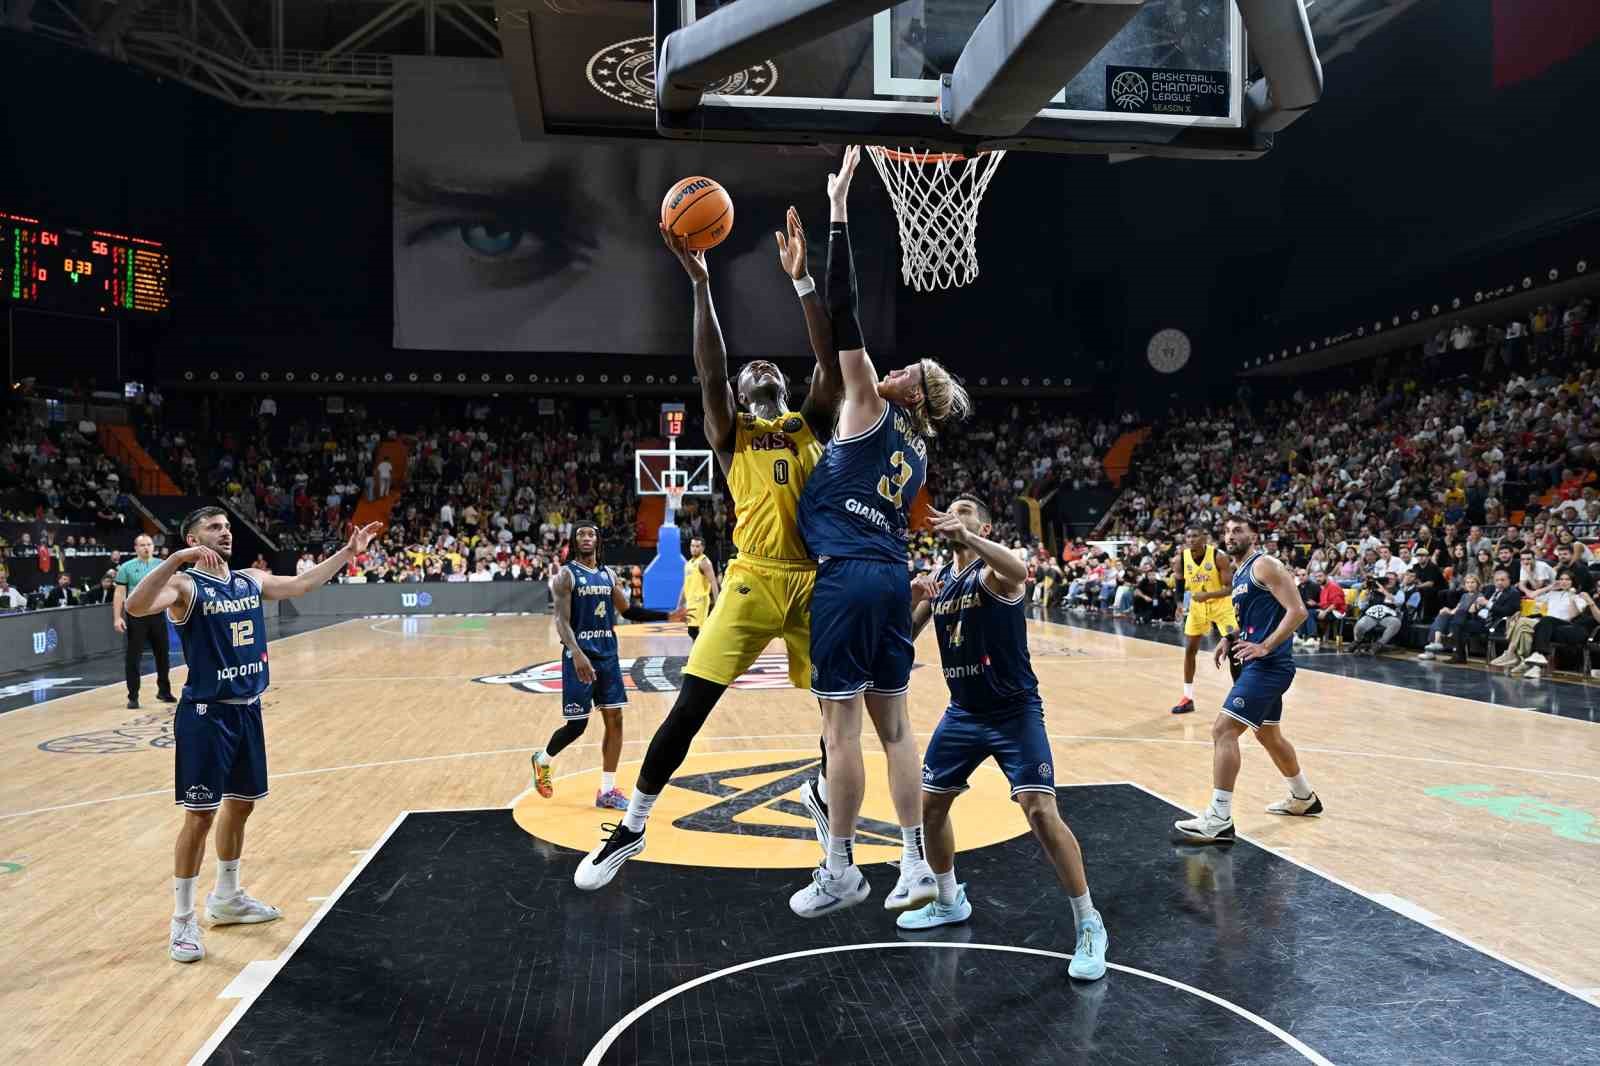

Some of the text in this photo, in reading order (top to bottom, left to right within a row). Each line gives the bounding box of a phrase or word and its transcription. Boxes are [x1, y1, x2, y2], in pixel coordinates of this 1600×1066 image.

[1152, 72, 1216, 83] BASKETBALL
[1152, 82, 1225, 94] CHAMPIONS
[1152, 93, 1192, 102] LEAGUE
[1152, 103, 1192, 113] SEASON X
[41, 231, 58, 246] 64
[91, 241, 108, 255] 56
[38, 268, 47, 281] 0
[70, 272, 78, 283] 4
[669, 421, 681, 434] 13
[774, 459, 789, 485] 0
[877, 450, 913, 510] 3
[594, 600, 607, 618] 4
[230, 620, 255, 647] 12
